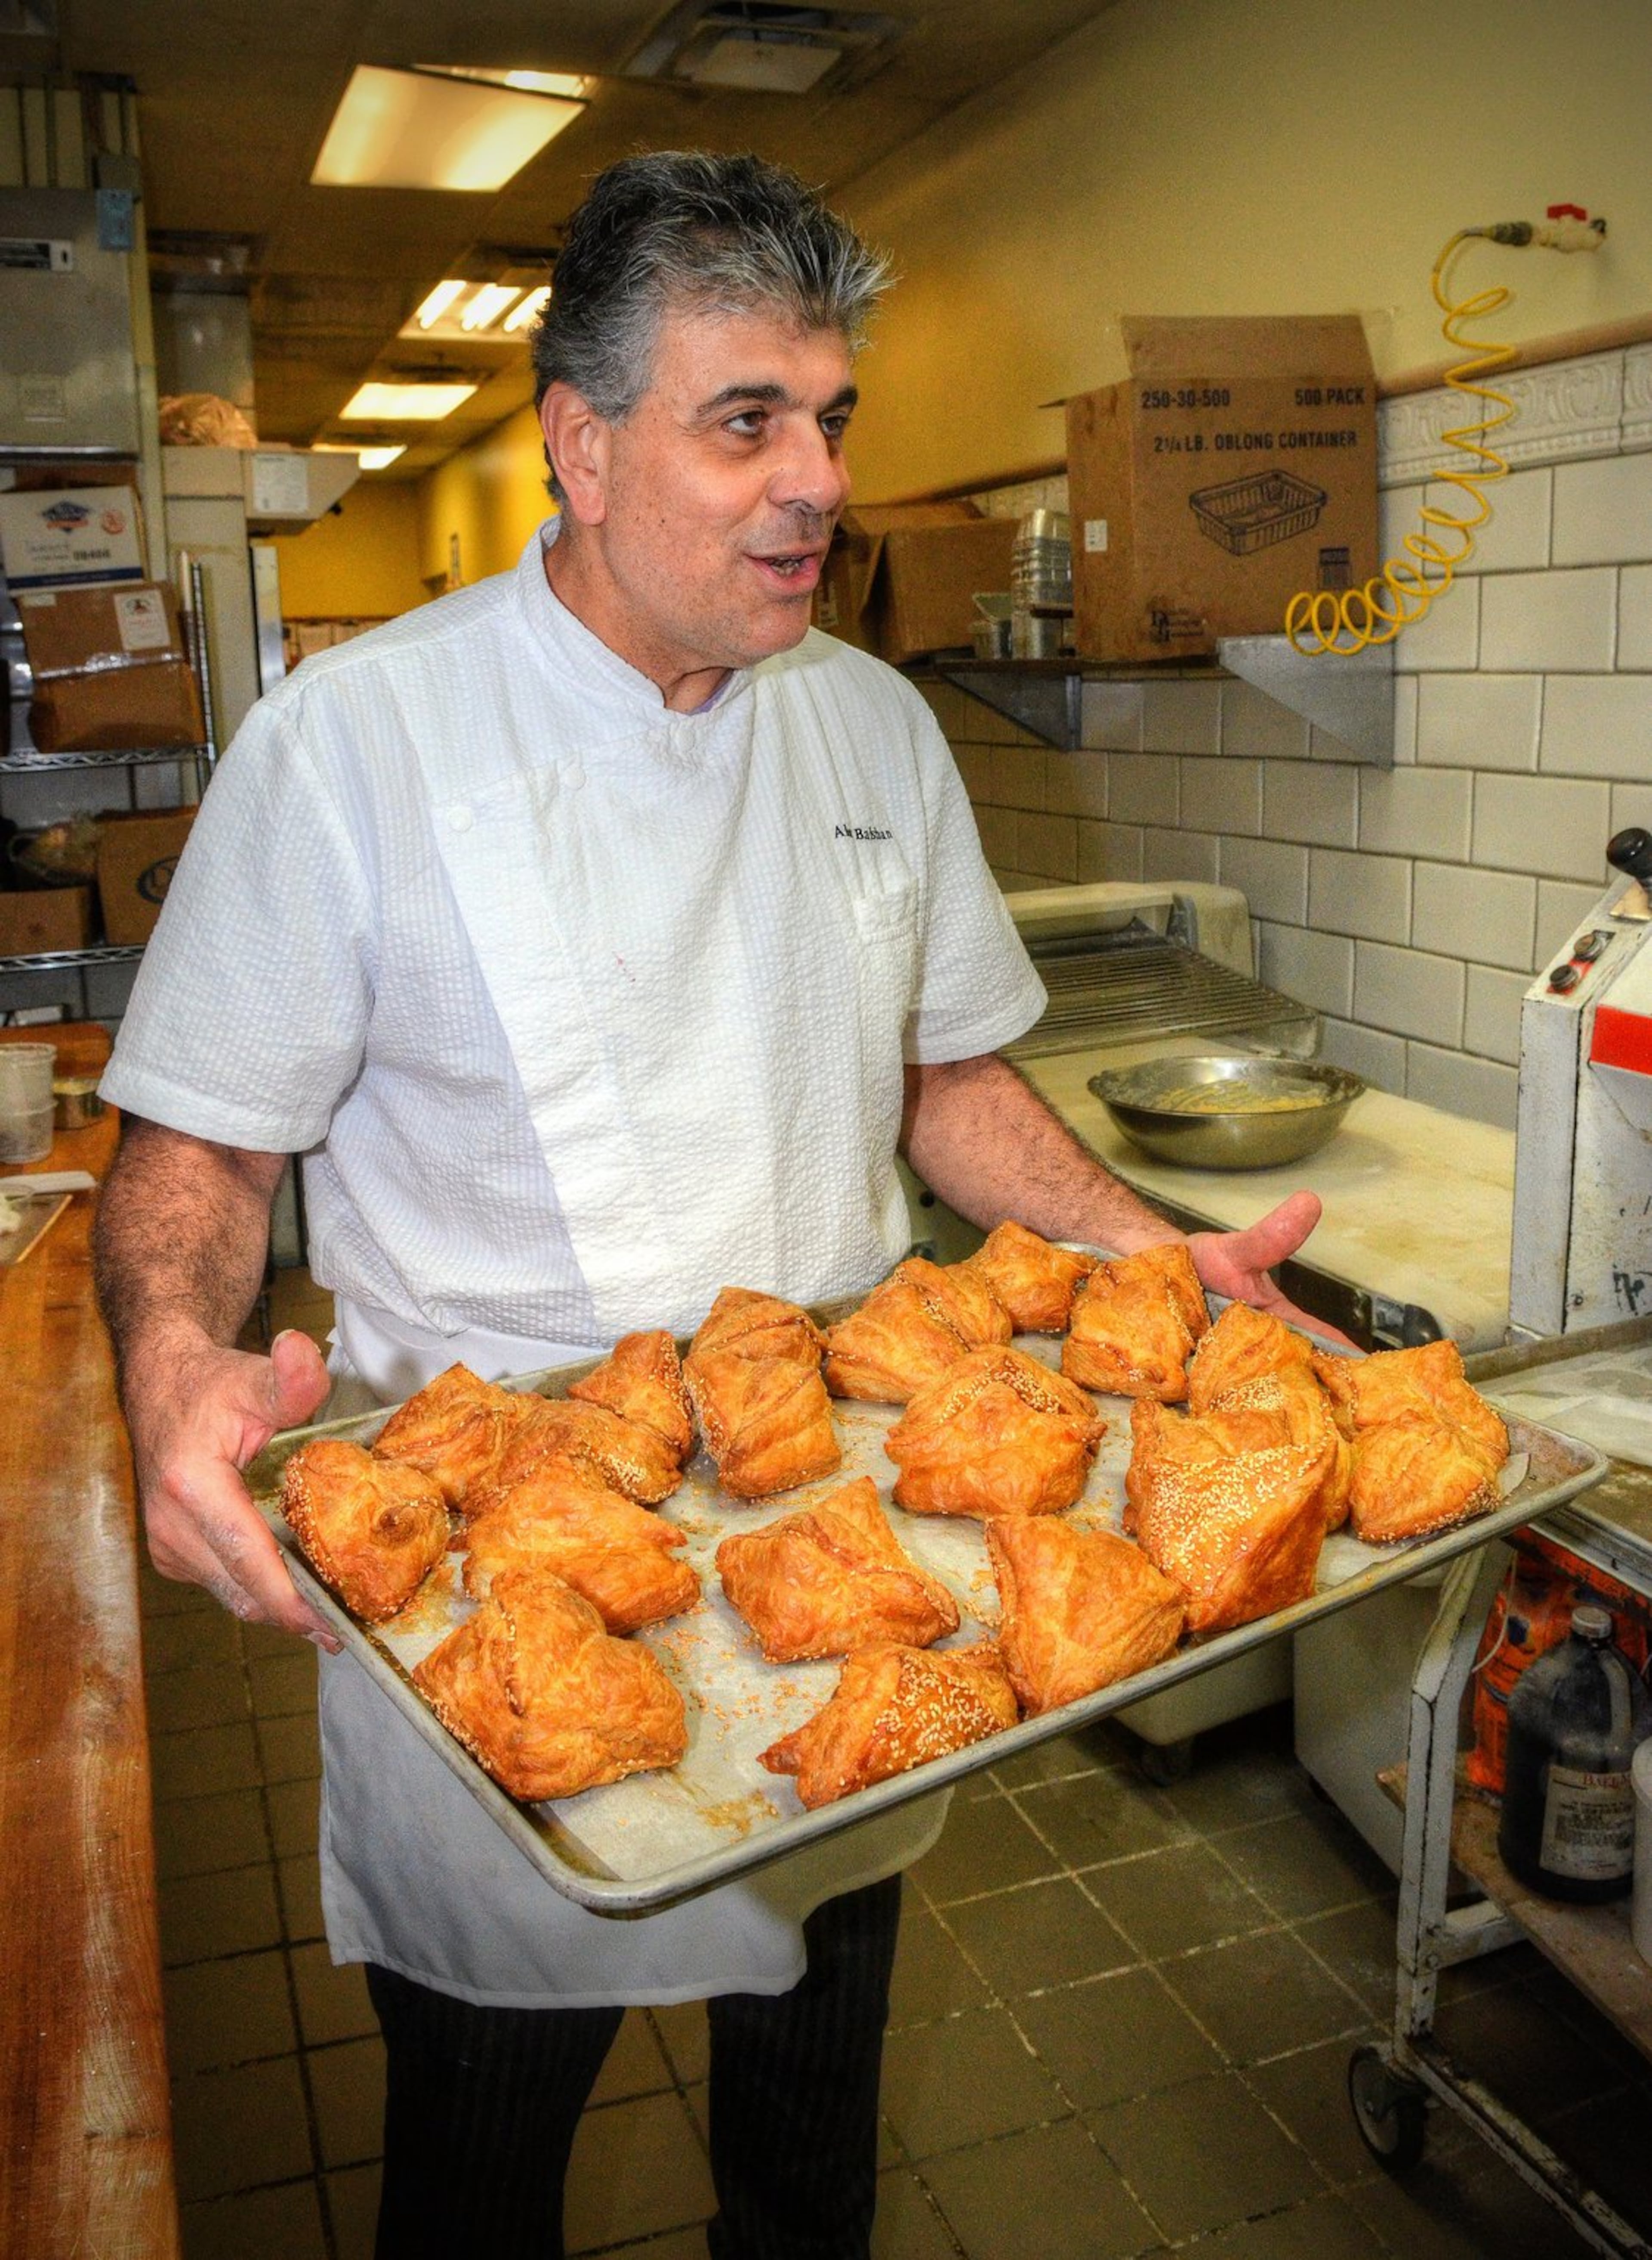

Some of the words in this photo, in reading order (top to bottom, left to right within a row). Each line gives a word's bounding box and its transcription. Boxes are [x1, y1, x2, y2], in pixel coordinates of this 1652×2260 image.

[1141, 389, 1231, 409] 250-30-500
[1295, 388, 1322, 406] 500
[1327, 387, 1365, 405] PACK
[1215, 433, 1273, 451] OBLONG
[1279, 431, 1357, 449] CONTAINER
